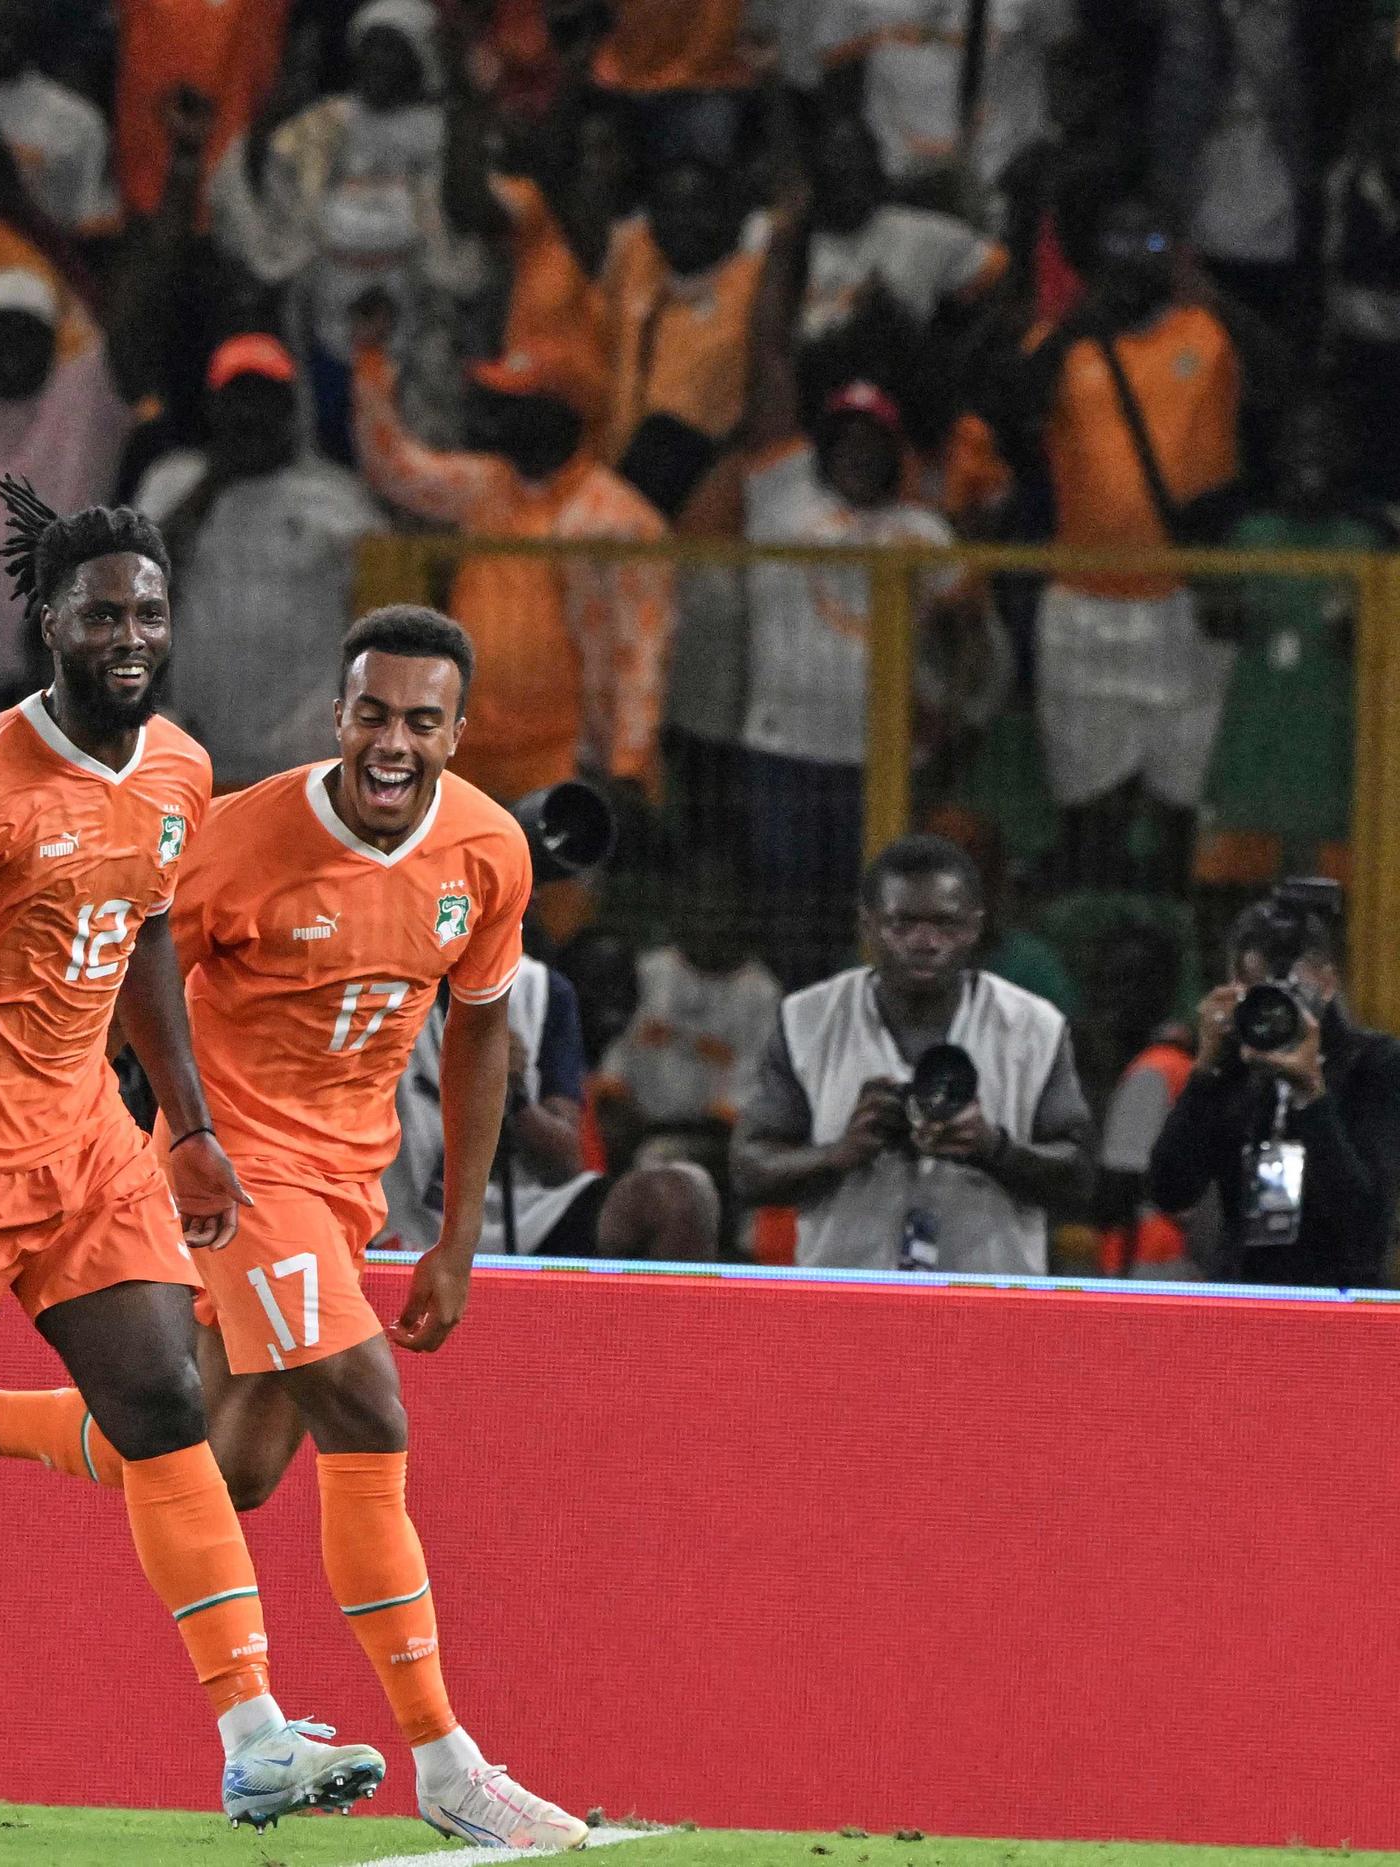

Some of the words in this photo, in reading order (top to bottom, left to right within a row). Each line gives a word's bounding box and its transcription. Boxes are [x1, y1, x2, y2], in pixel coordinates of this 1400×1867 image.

[40, 842, 74, 858] PUMA
[65, 900, 133, 981] 12
[293, 926, 331, 940] PUMA
[328, 981, 410, 1052] 17
[246, 1252, 319, 1352] 17
